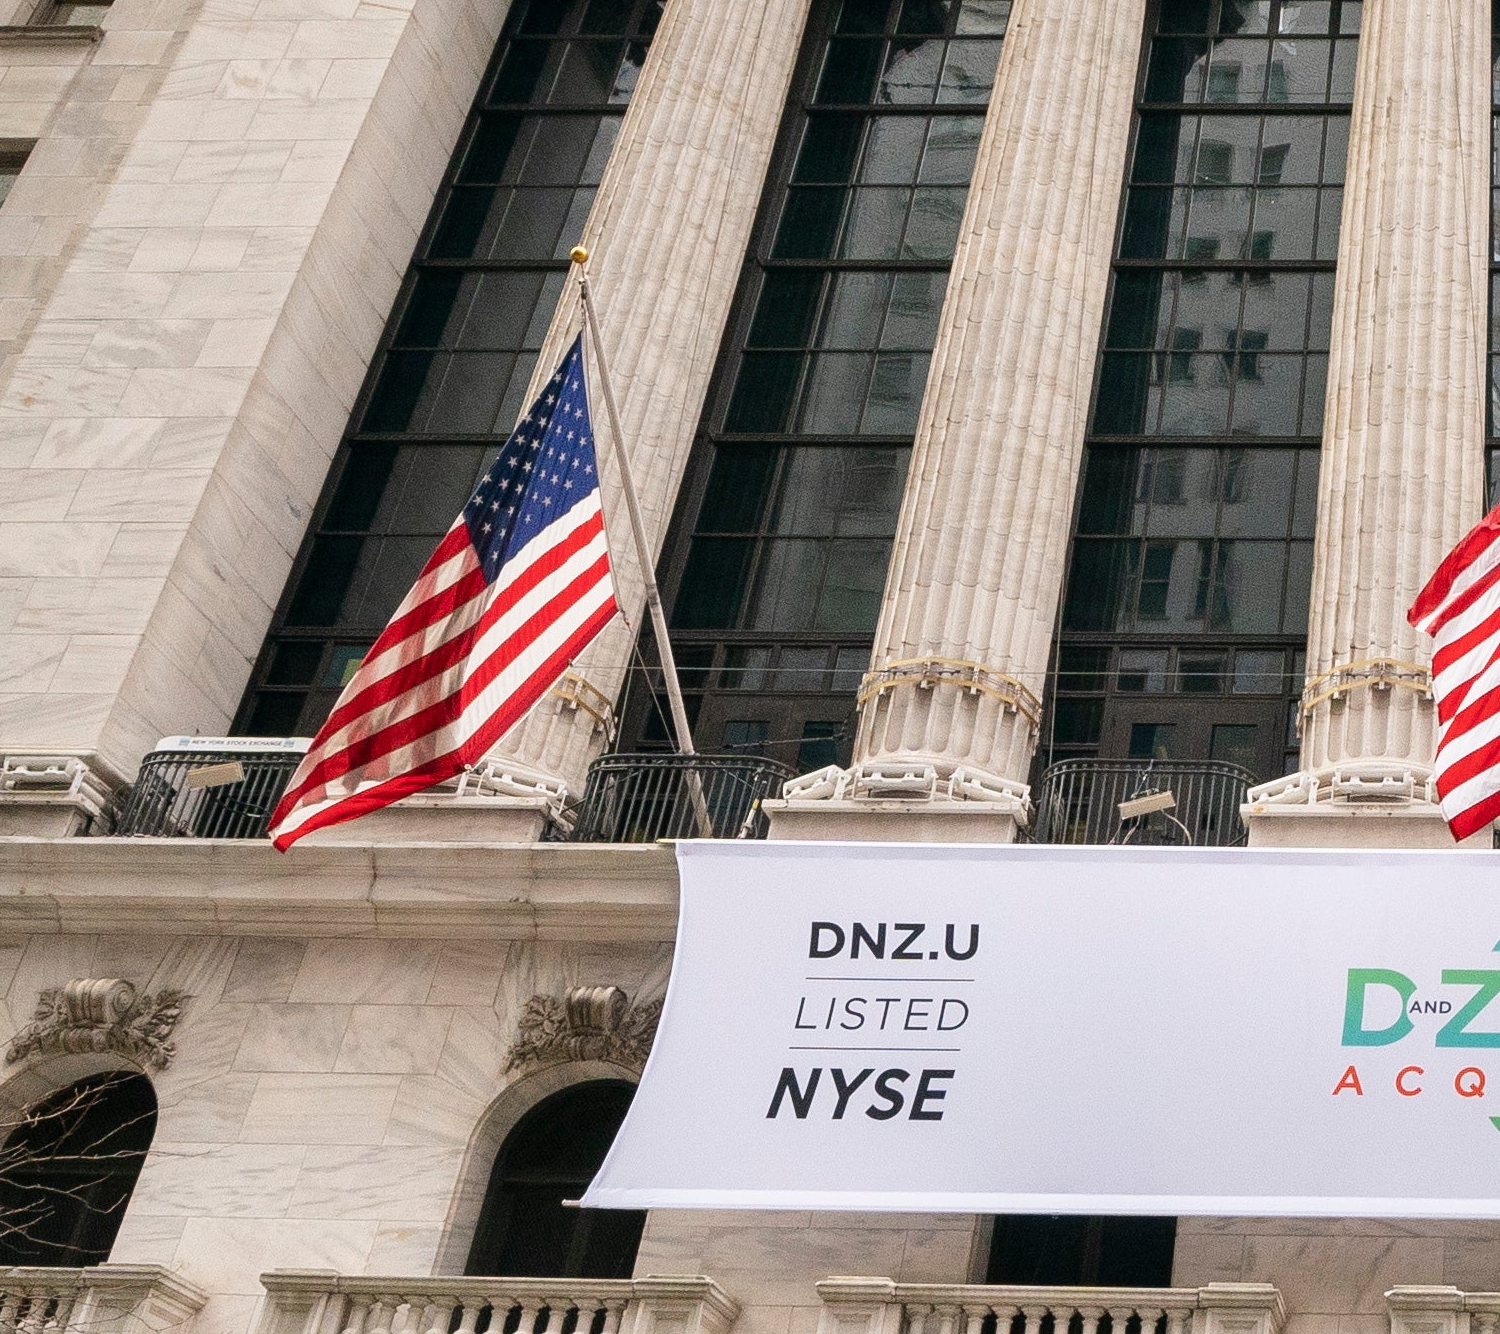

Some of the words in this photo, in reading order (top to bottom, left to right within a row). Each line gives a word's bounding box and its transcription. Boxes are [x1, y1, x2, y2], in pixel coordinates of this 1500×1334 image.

[808, 921, 980, 961] DNZ.U
[794, 997, 969, 1030] LISTED
[765, 1067, 956, 1121] NYSE
